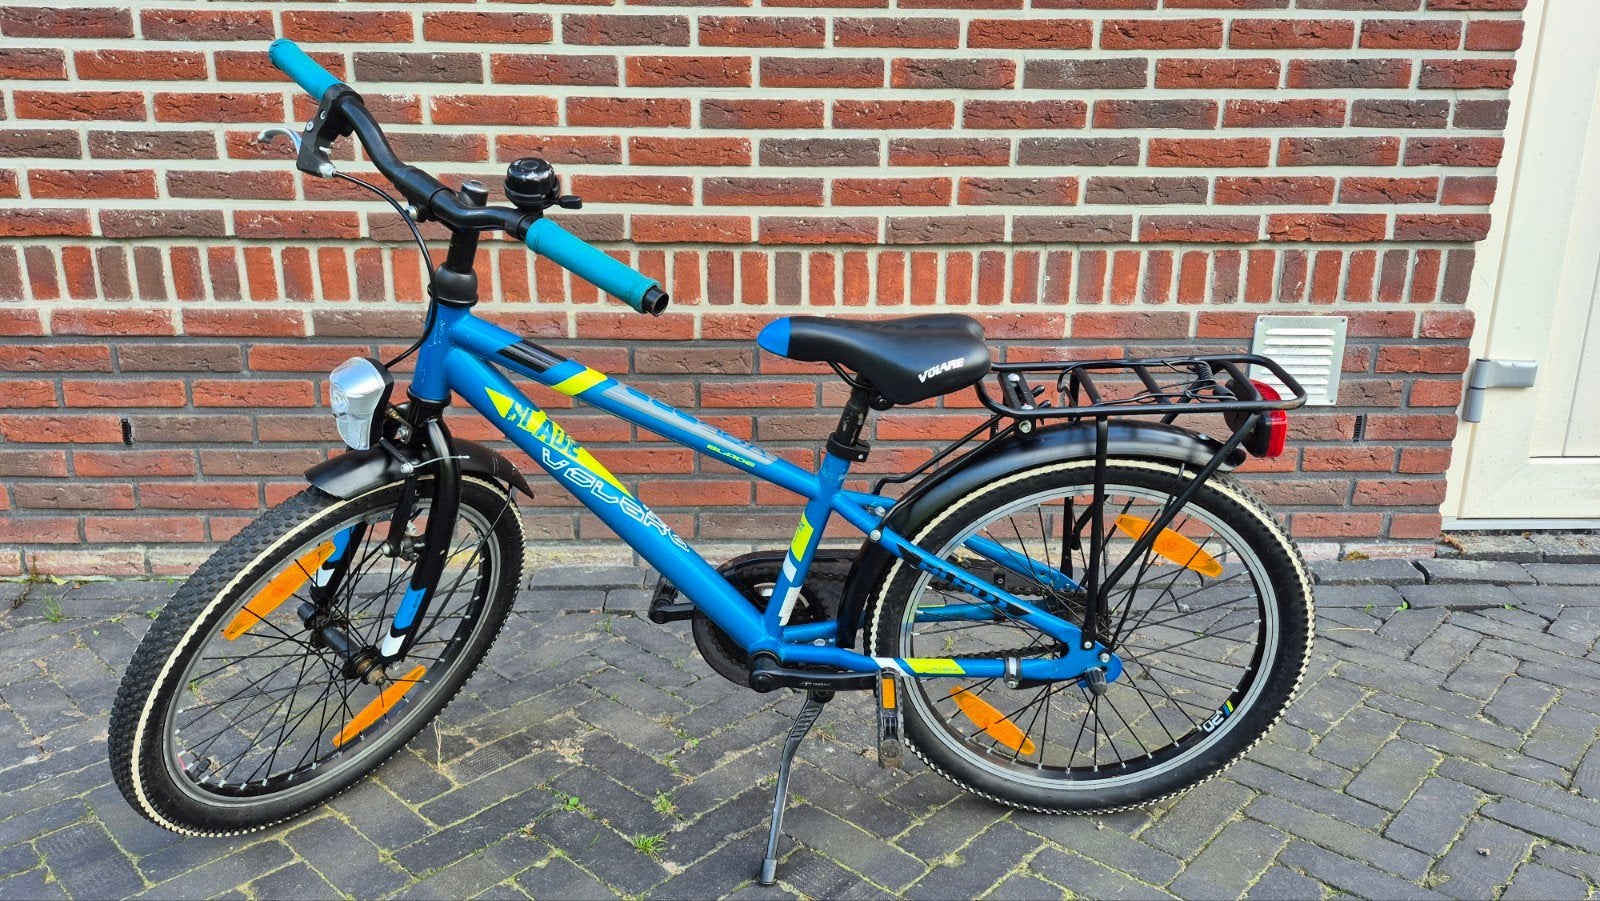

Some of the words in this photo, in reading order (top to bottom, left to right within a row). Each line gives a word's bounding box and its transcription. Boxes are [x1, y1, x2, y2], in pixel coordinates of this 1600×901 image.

[918, 357, 965, 383] VOLARE
[706, 444, 756, 468] BLADE
[542, 446, 690, 552] VOLARE
[1202, 714, 1225, 732] 20
